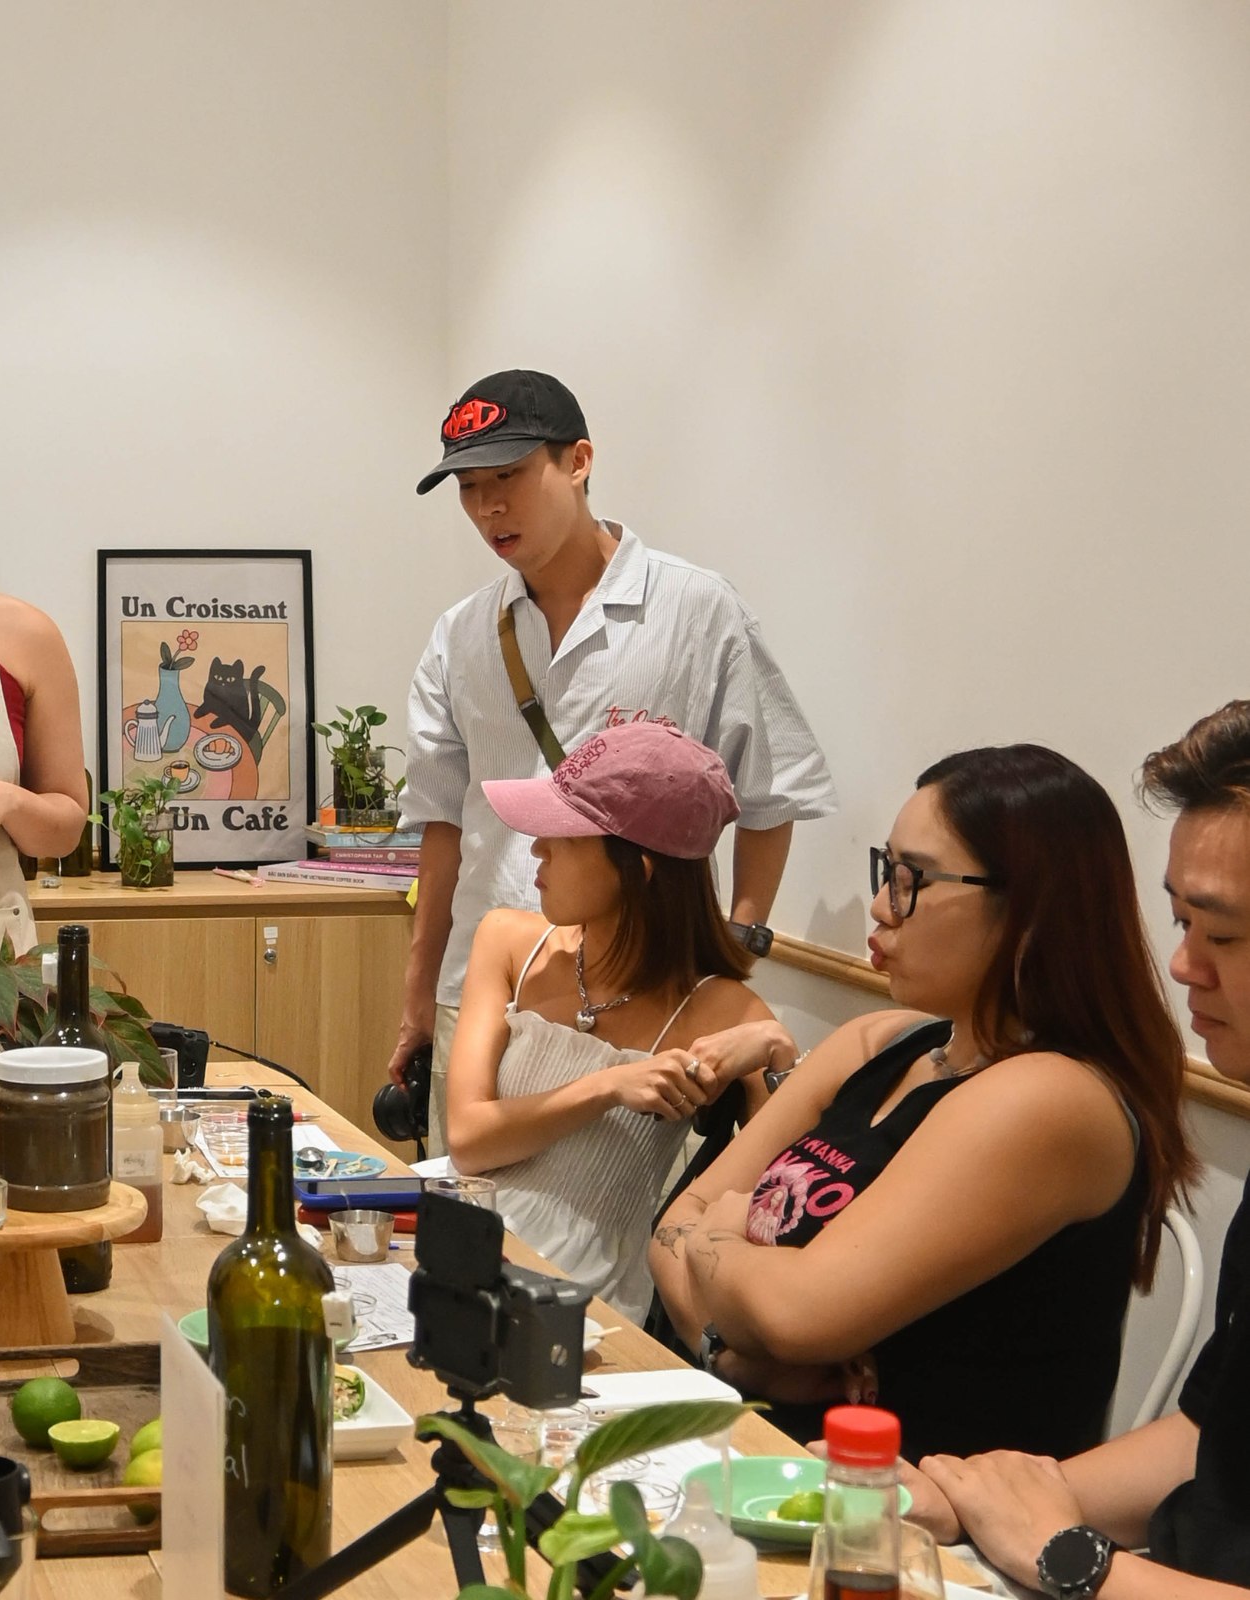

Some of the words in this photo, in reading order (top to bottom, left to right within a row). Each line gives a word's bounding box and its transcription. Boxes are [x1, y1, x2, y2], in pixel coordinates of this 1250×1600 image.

[121, 596, 156, 617] Un
[166, 596, 288, 619] Croissant
[169, 806, 210, 831] Un
[222, 806, 289, 831] Café
[796, 1137, 810, 1146] I
[804, 1140, 856, 1174] WANNA
